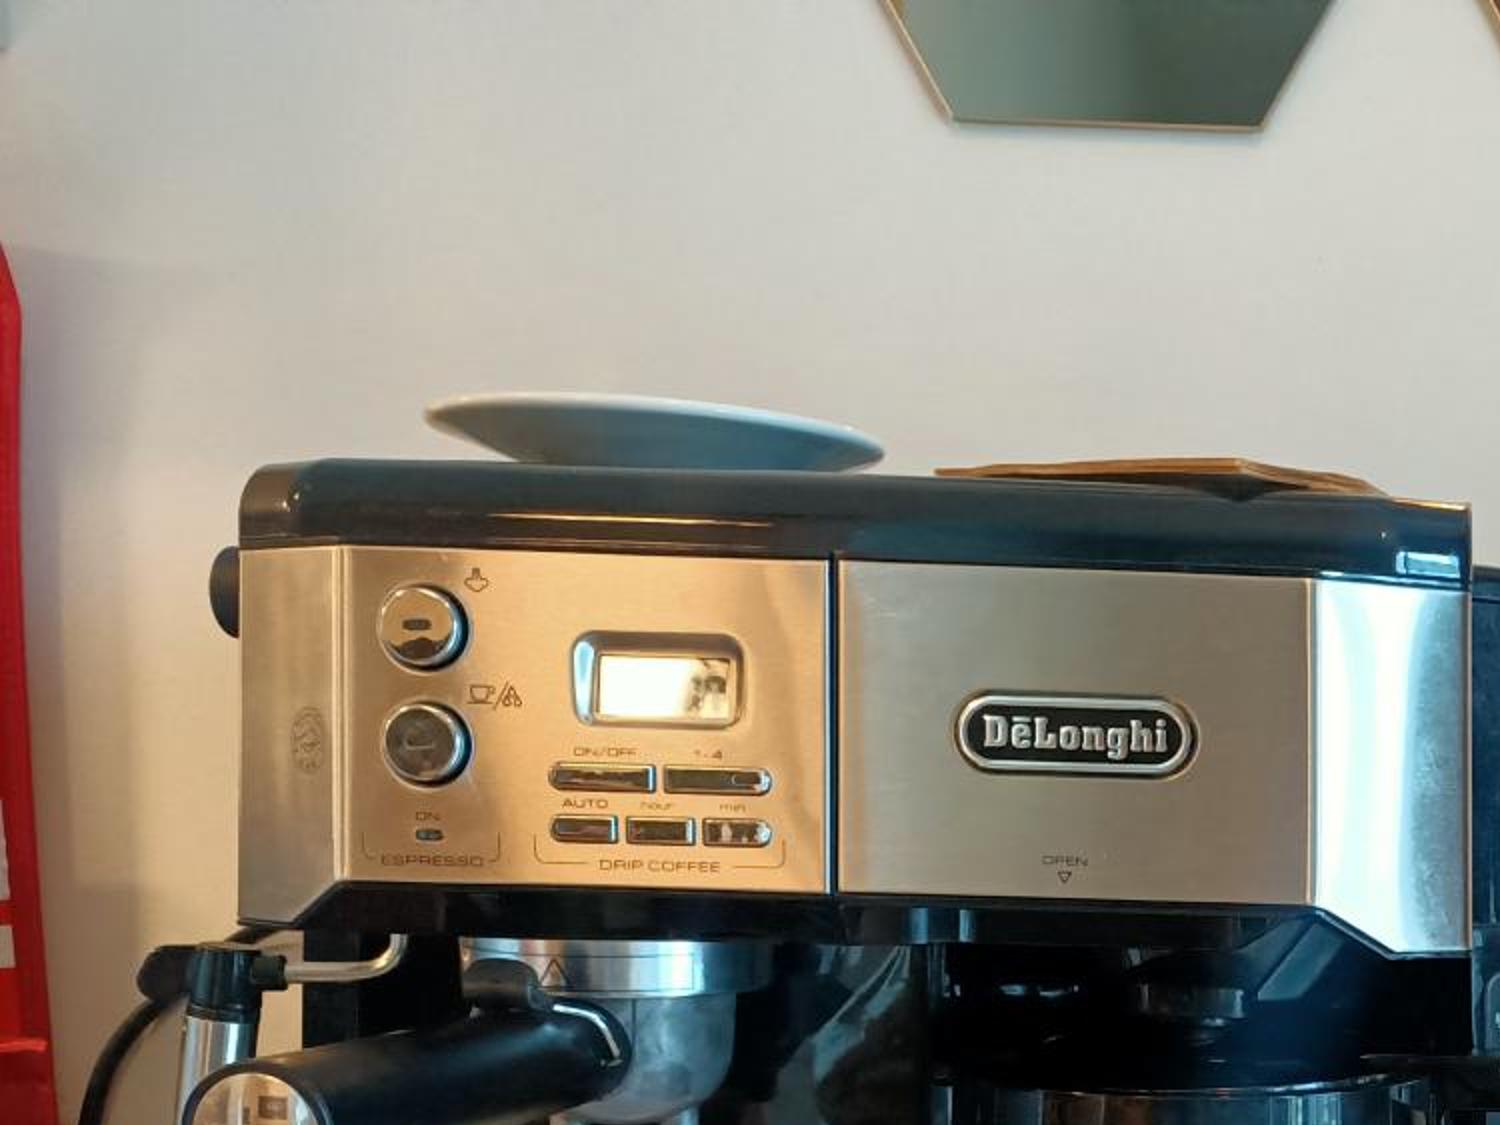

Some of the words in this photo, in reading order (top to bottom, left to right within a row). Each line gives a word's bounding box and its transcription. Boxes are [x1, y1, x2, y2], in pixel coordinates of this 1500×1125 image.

[562, 799, 609, 809] AUTO
[416, 811, 440, 821] ON
[381, 855, 483, 867] ESPRESSO
[600, 859, 643, 871] DRIP
[647, 861, 721, 872] COFFEE
[1042, 855, 1088, 866] OPEN
